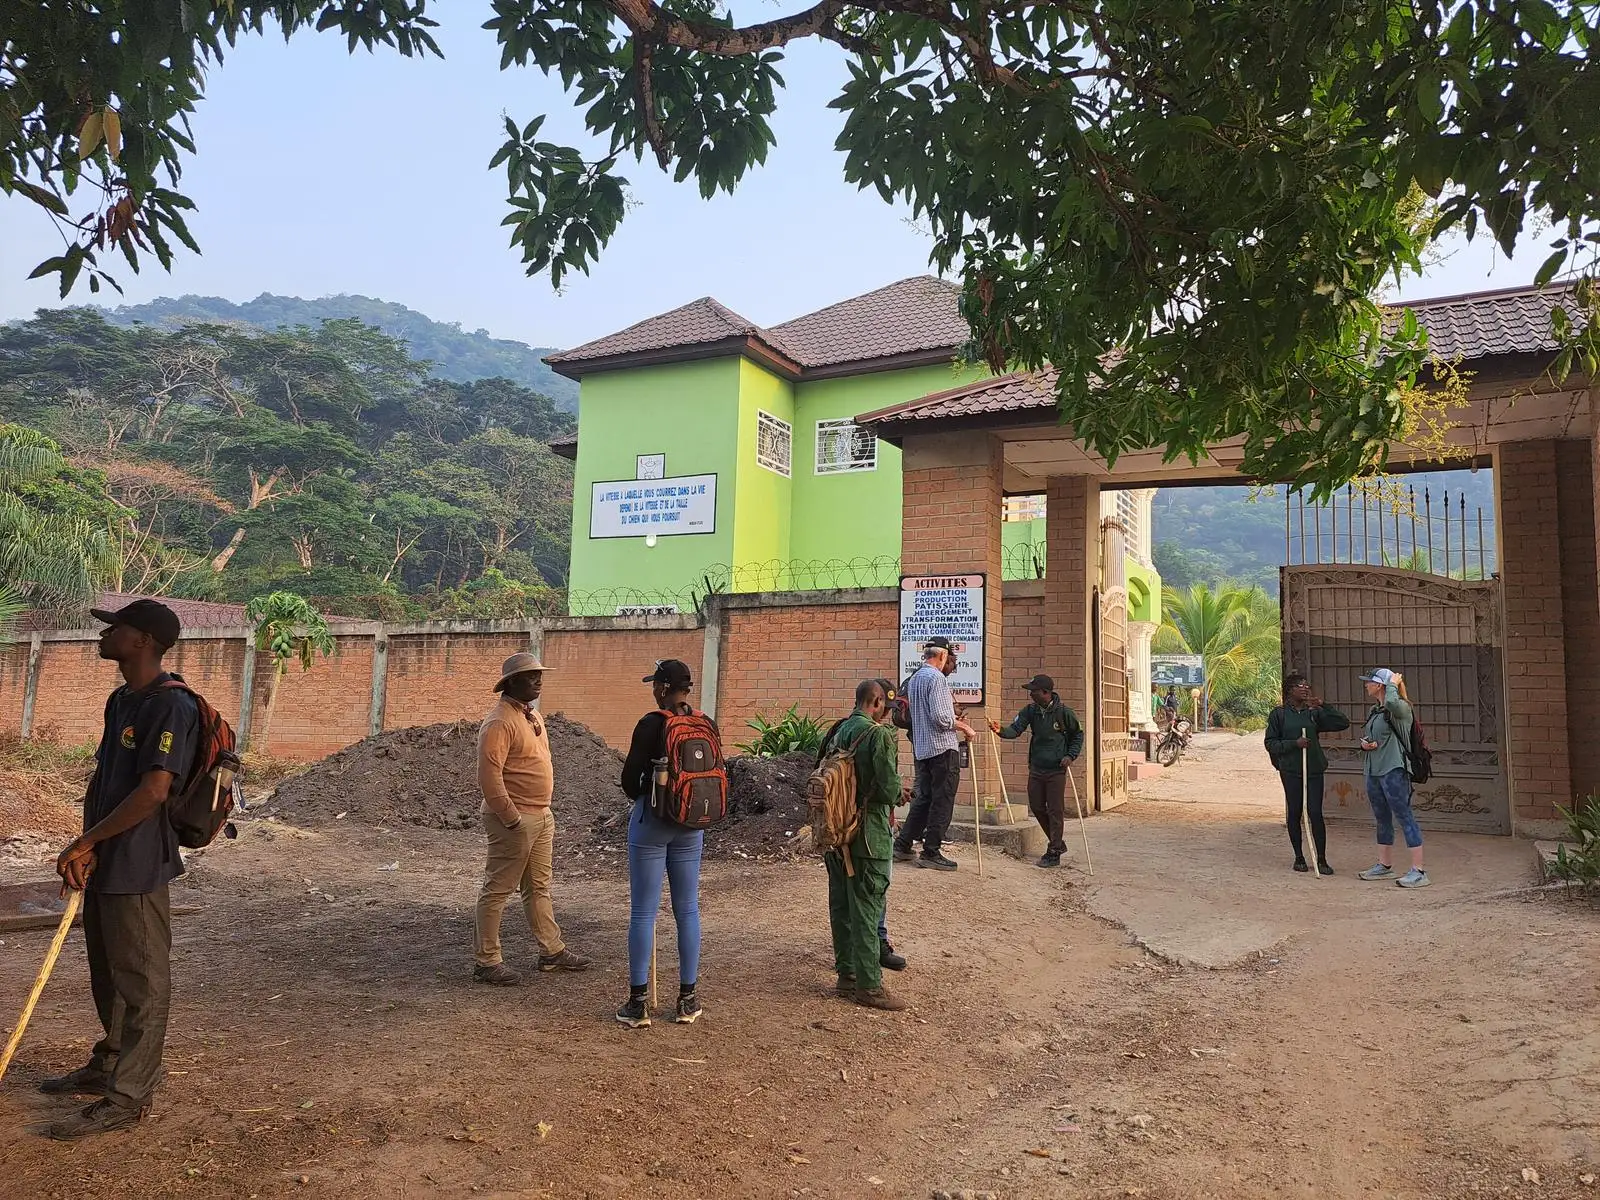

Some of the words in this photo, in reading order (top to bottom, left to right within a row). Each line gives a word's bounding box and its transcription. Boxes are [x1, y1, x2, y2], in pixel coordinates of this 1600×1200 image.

[624, 490, 642, 499] LAQUELLE
[644, 488, 654, 498] VOUS
[656, 488, 676, 496] COURREZ
[678, 486, 690, 496] DANS
[690, 486, 696, 494] LA
[696, 485, 706, 494] VIE
[634, 502, 638, 511] DE
[640, 502, 644, 510] LA
[664, 500, 669, 509] DE
[670, 499, 674, 509] LA
[676, 498, 688, 508] TAILLE
[628, 514, 640, 524] CHIEN
[650, 513, 660, 522] VOUS
[914, 578, 967, 588] ACTIVITES
